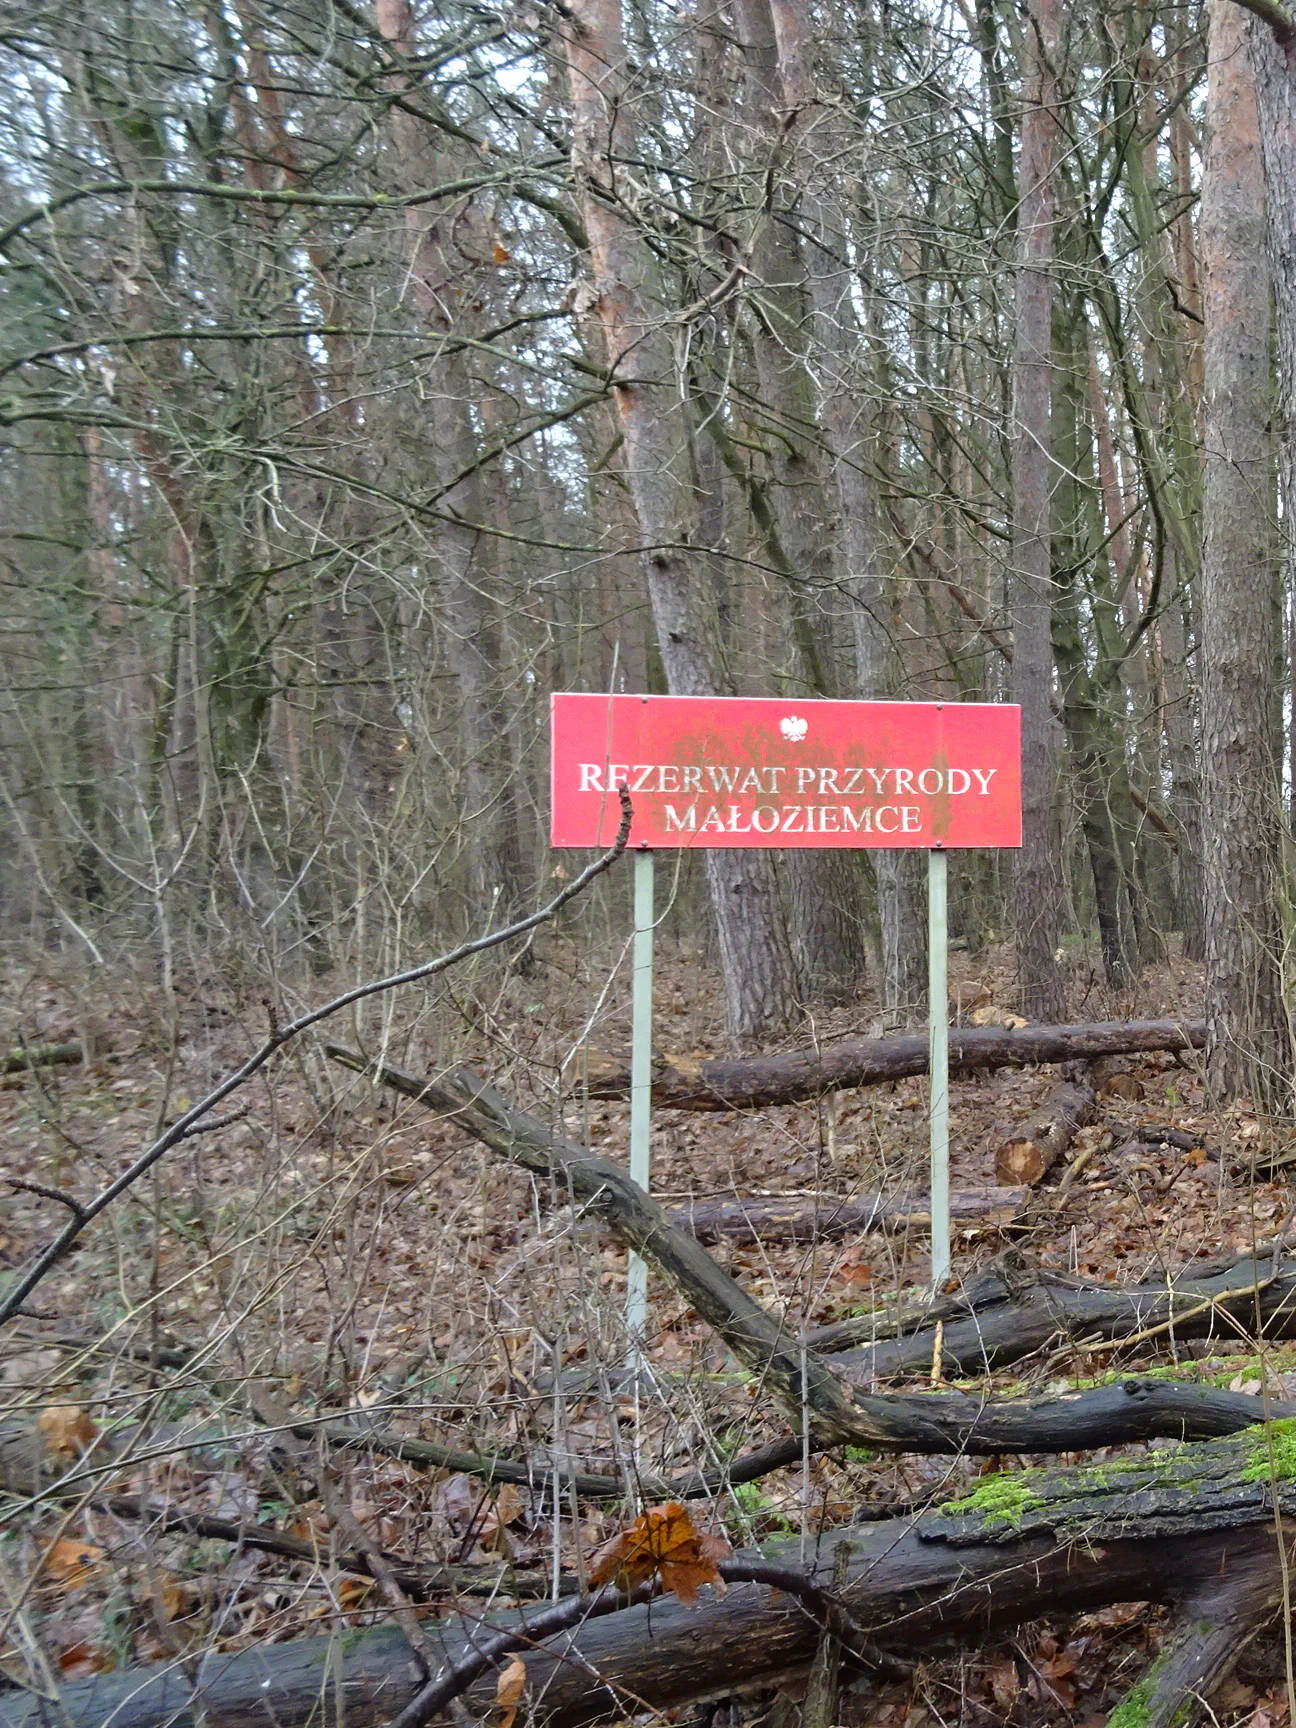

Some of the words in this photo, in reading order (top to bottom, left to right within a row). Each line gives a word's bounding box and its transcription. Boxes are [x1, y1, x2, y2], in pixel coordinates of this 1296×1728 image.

[578, 763, 786, 794] REZERWAT
[795, 767, 998, 796] PRZYRODY
[665, 804, 923, 833] MAŁOZIEMCE
